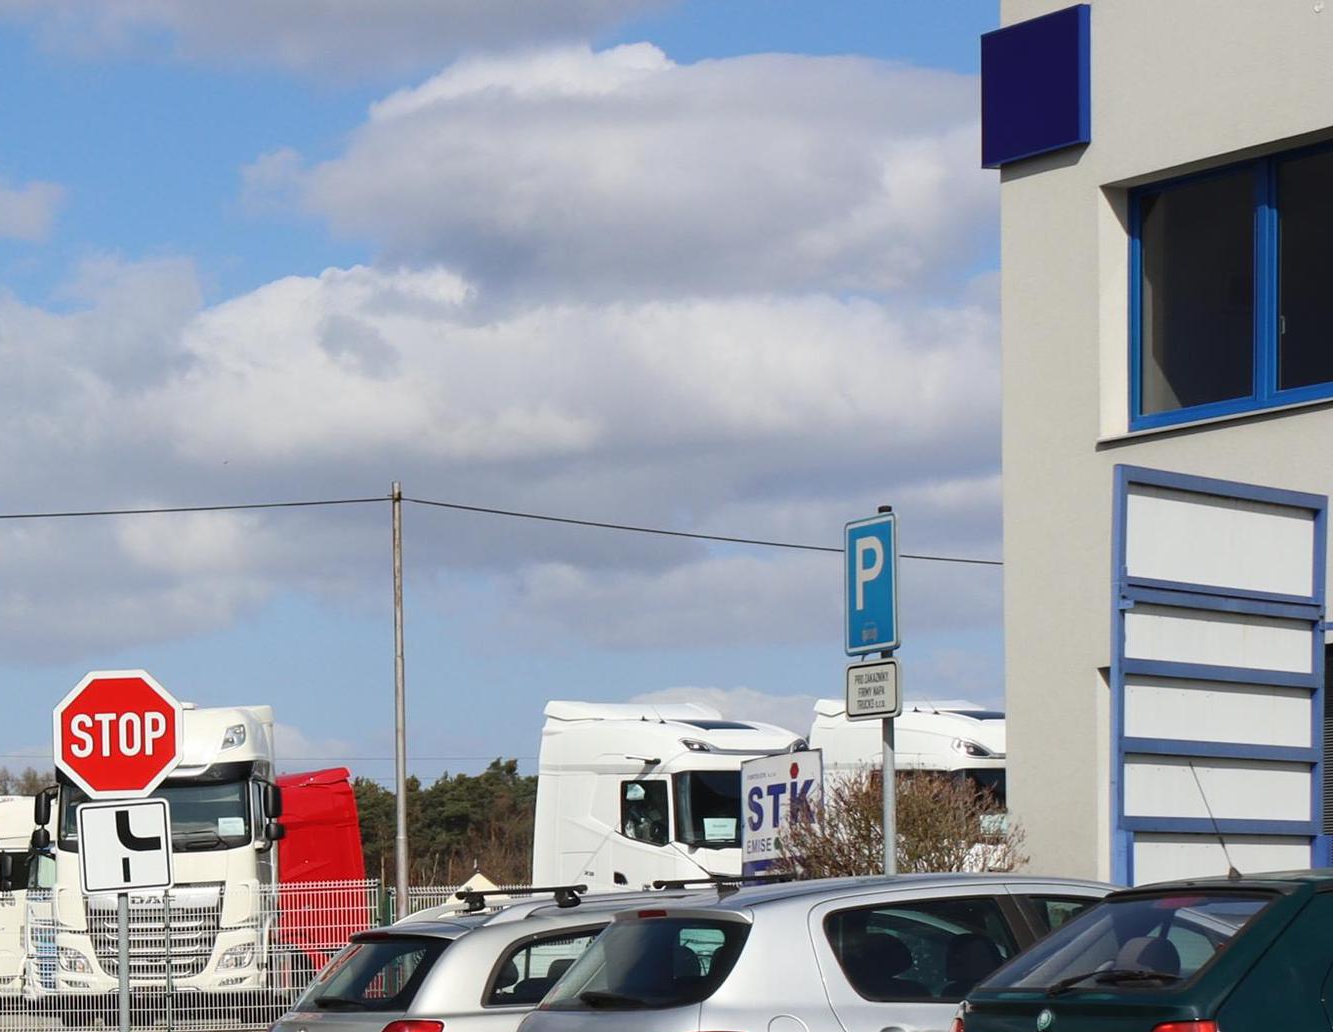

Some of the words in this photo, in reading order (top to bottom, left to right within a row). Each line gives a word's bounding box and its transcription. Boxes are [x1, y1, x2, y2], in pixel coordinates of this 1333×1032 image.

[856, 536, 884, 611] P
[70, 711, 167, 758] STOP
[748, 779, 815, 832] STK
[746, 838, 772, 855] EMISE
